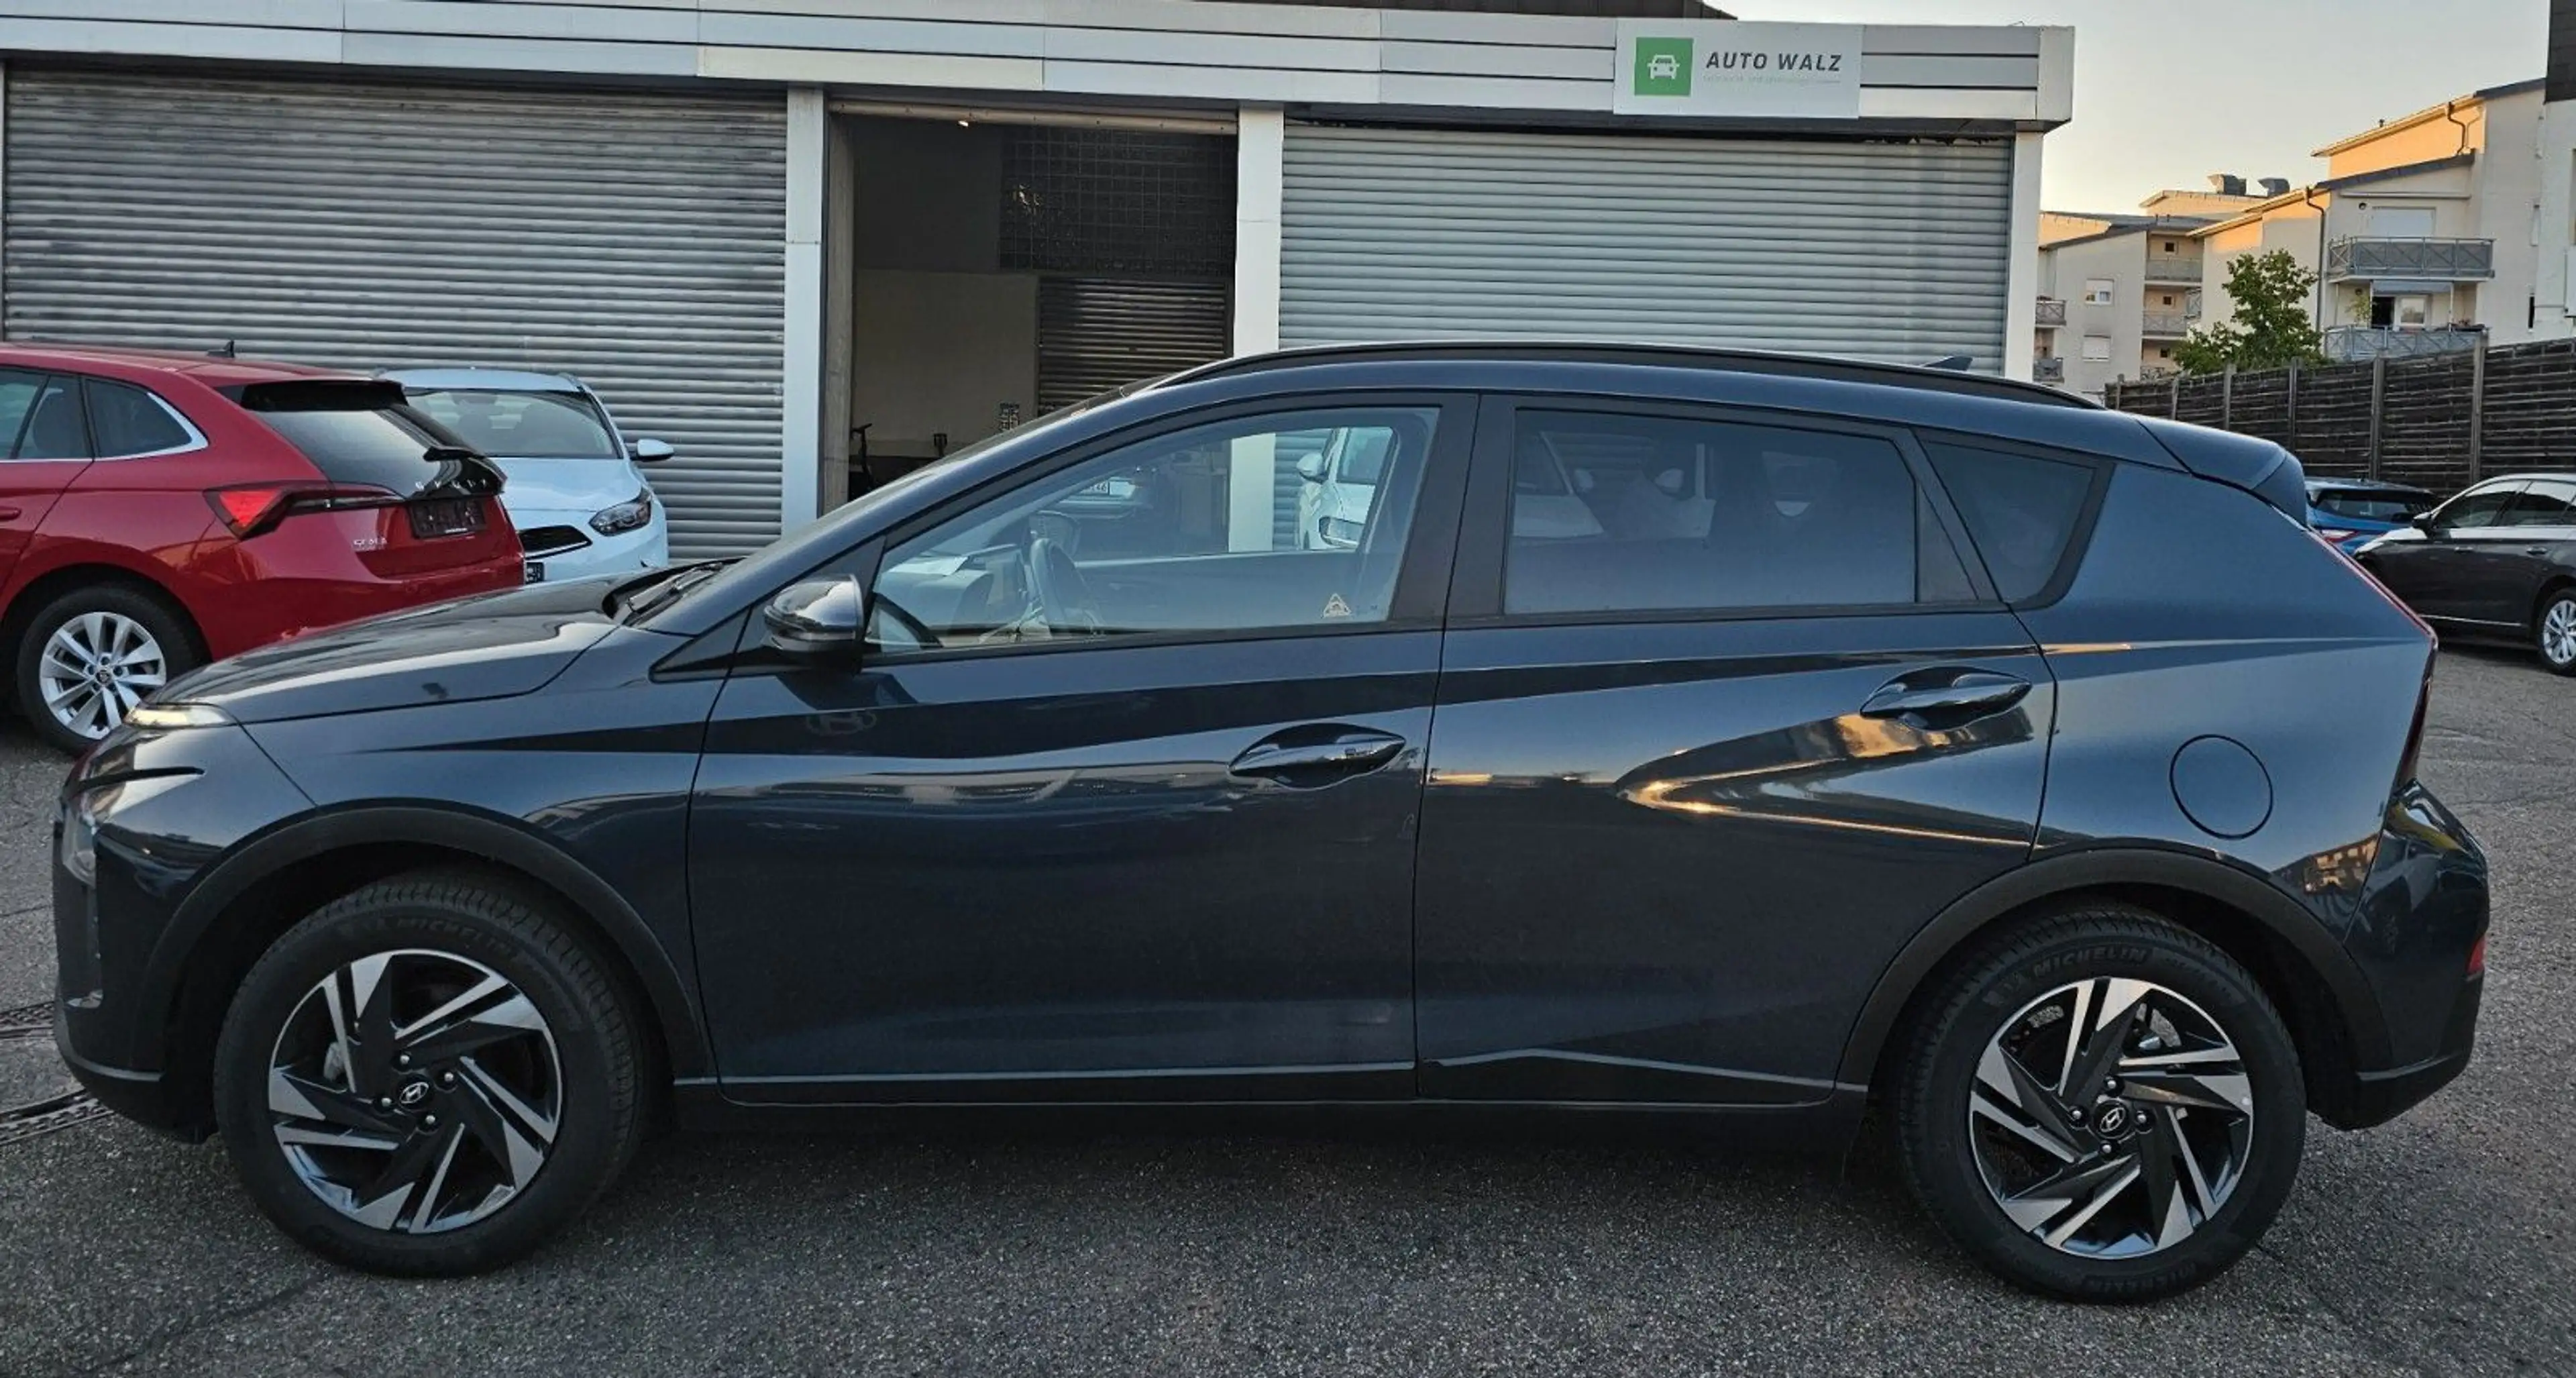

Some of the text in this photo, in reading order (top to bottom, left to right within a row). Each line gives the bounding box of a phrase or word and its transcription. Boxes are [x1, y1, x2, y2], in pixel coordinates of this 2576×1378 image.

[1706, 52, 1841, 71] AUTO WALZ
[2034, 946, 2147, 977] MICHELIN
